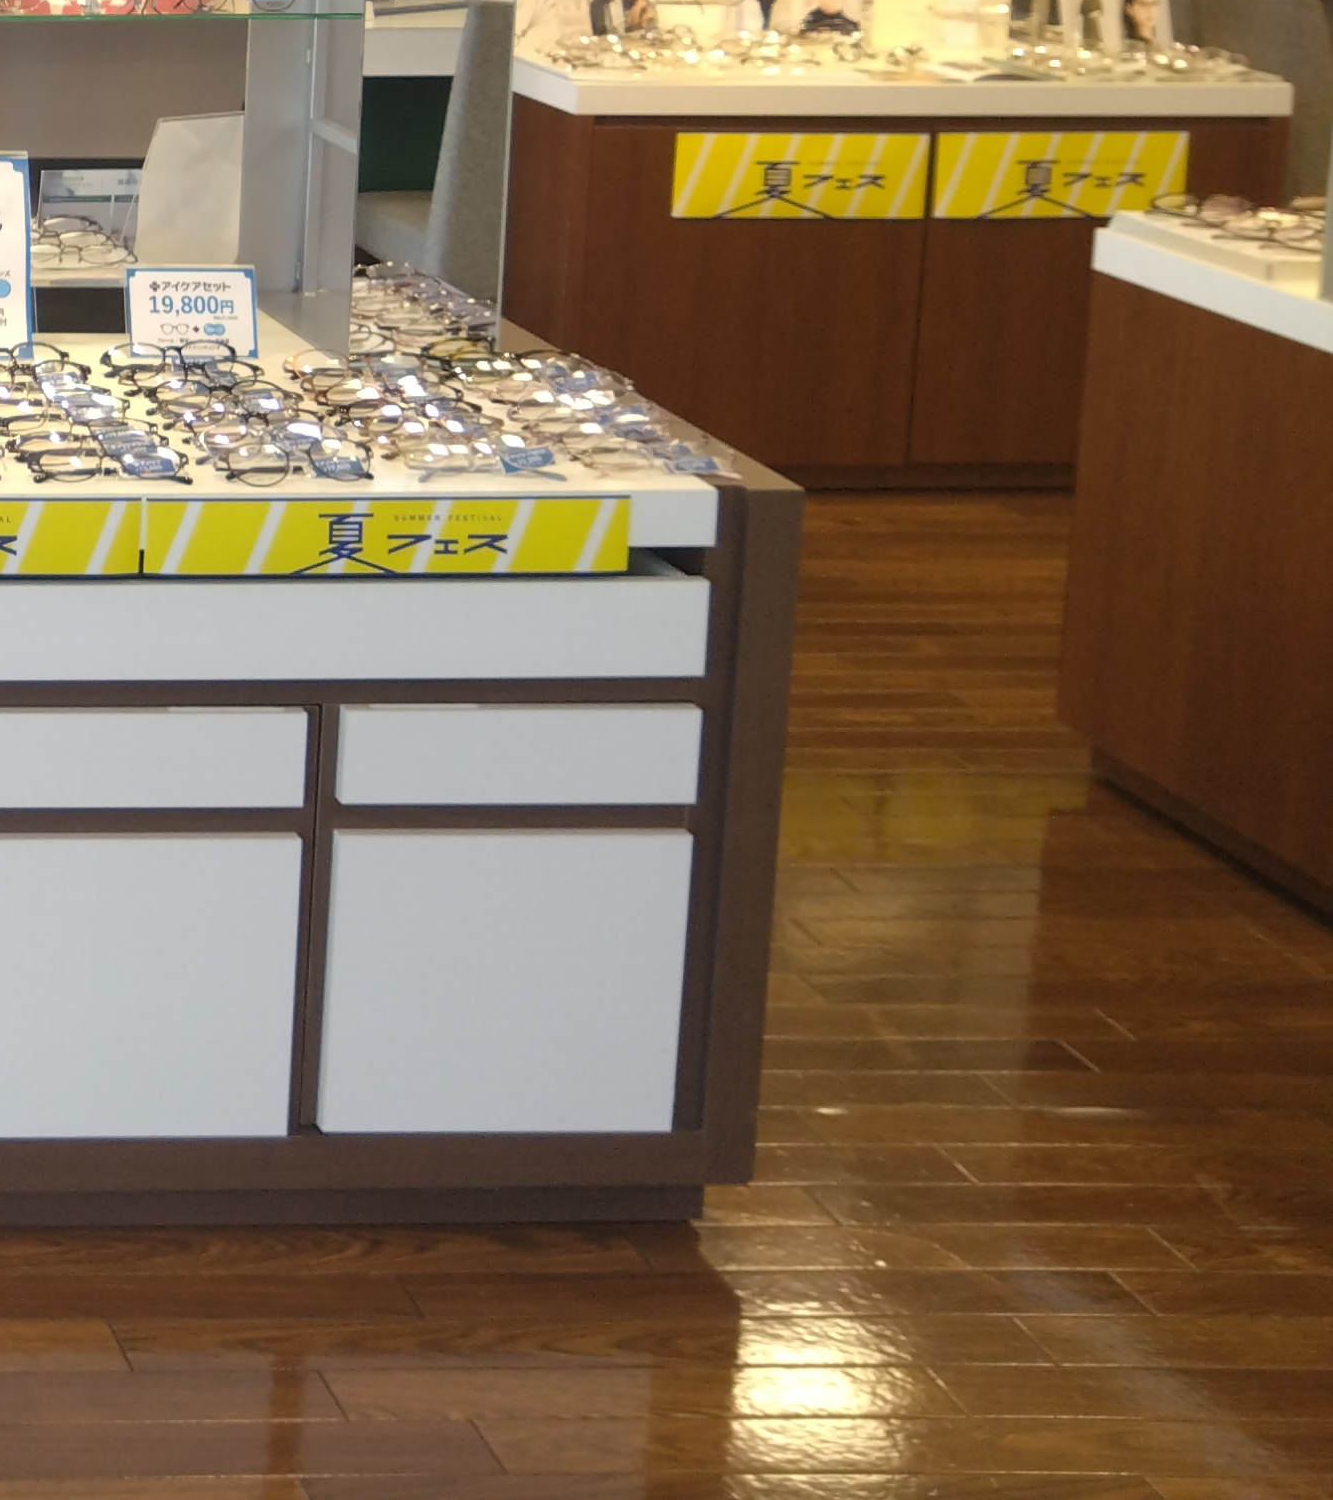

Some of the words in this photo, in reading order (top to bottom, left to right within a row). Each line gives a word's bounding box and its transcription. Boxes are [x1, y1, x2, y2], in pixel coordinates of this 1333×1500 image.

[149, 295, 234, 317] 19,800円
[393, 514, 441, 522] SUMMER
[448, 513, 503, 522] FESTIVAL
[290, 512, 508, 575] 夏フェス
